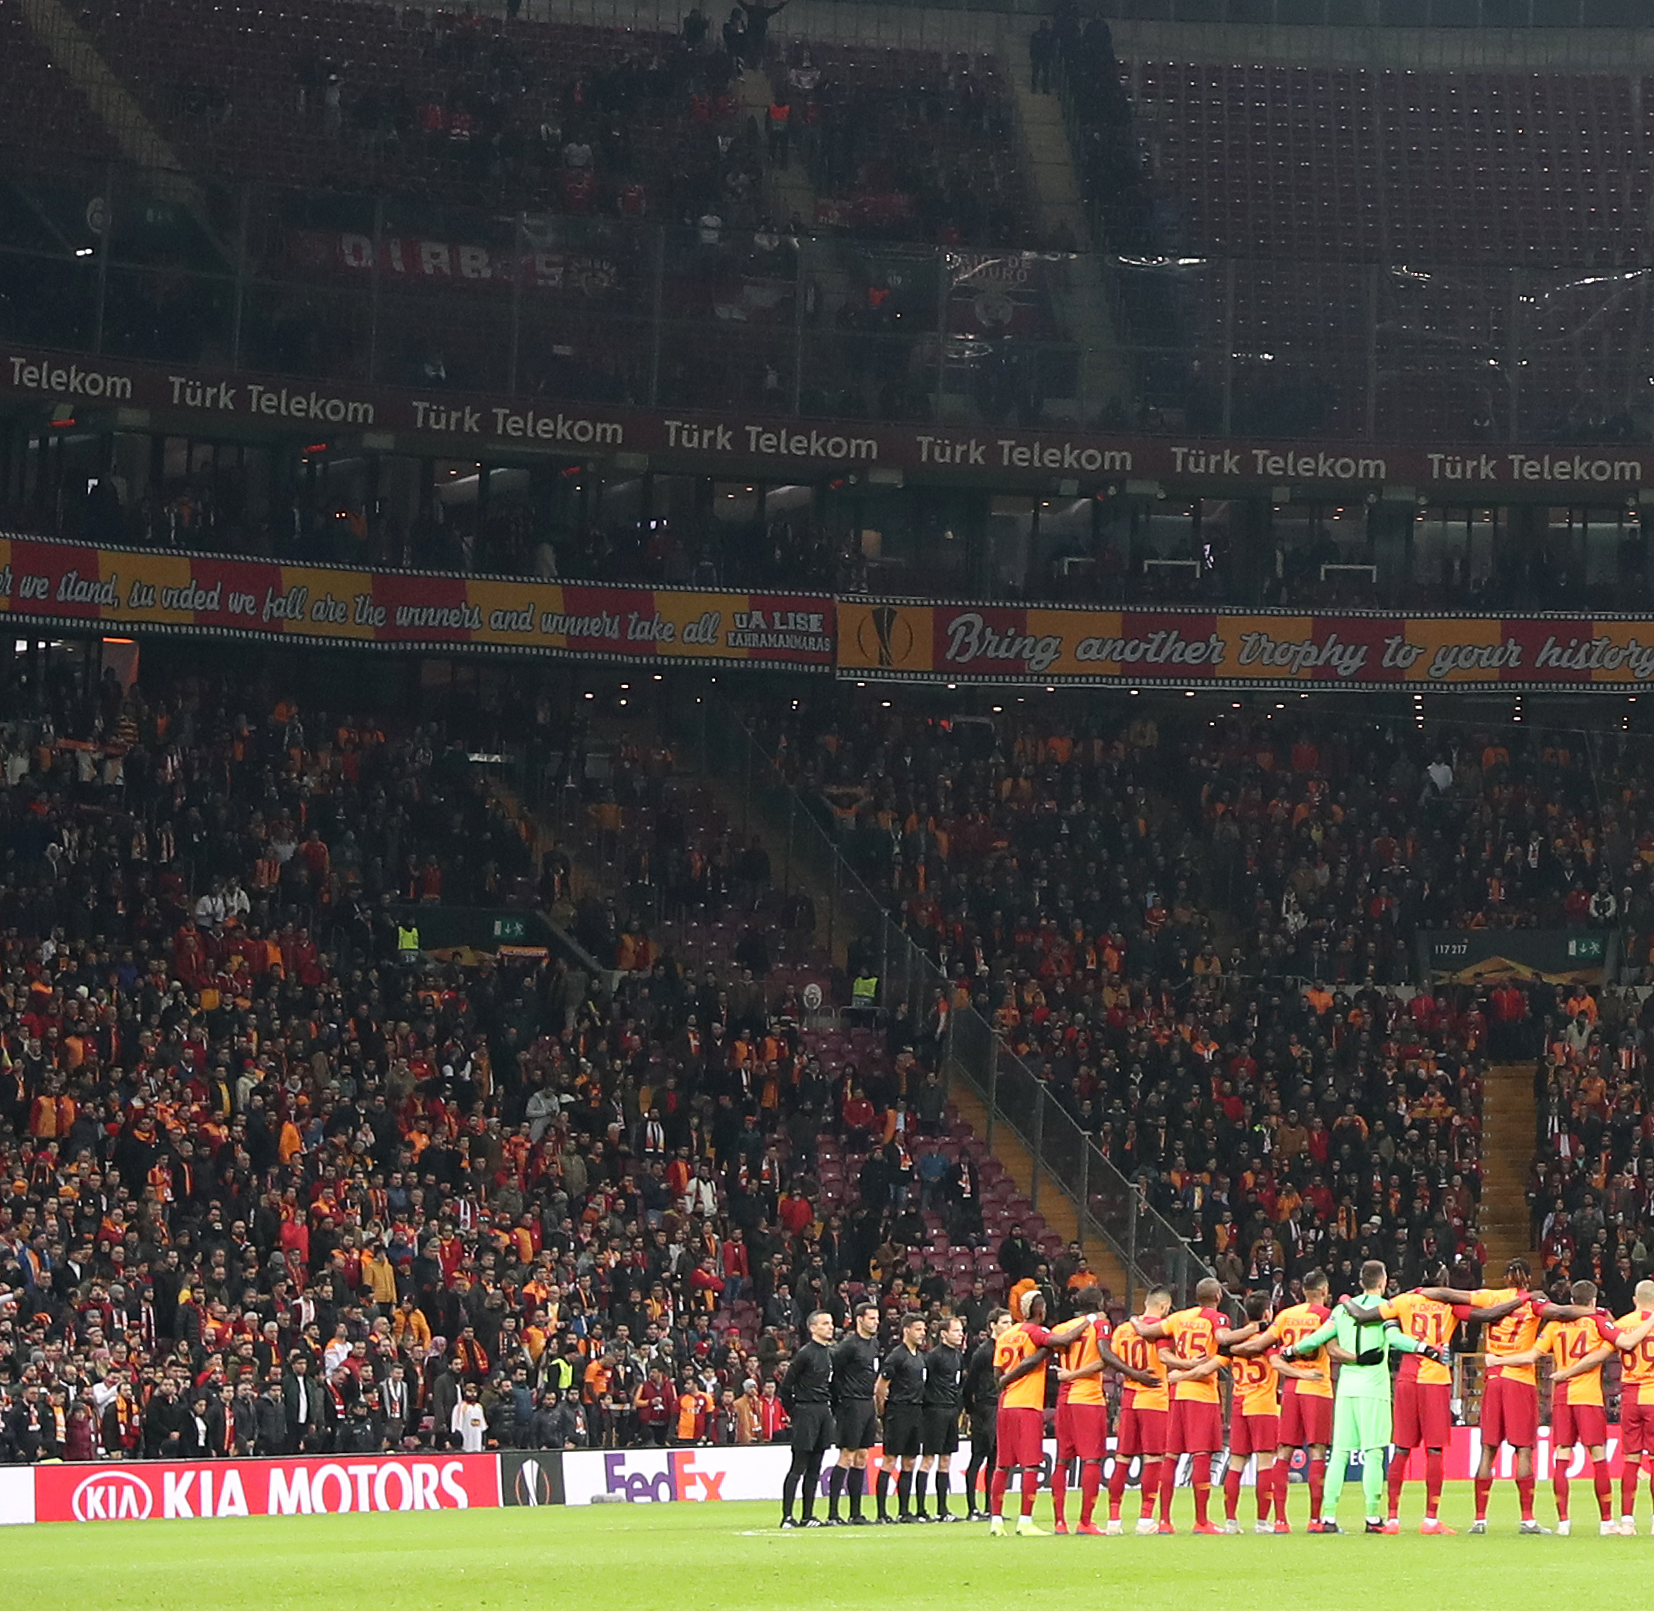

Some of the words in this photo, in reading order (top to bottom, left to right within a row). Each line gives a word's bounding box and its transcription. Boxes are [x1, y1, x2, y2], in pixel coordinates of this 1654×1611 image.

[10, 357, 131, 398] Telekom
[169, 376, 236, 409] Türk
[247, 385, 373, 423] Telekom
[412, 401, 481, 432] Türk
[492, 408, 622, 443] Telekom
[665, 421, 732, 450] Türk
[745, 426, 877, 459] Telekom
[917, 436, 985, 464] Türk
[998, 440, 1131, 470] Telekom
[1171, 447, 1240, 474] Türk
[1252, 450, 1385, 478] Telekom
[1427, 454, 1496, 479] Türk
[1508, 455, 1641, 481] Telekom
[19, 575, 48, 600] we
[56, 570, 118, 608] stand,
[228, 592, 256, 616] we
[261, 586, 307, 623] fall
[311, 596, 347, 623] are
[355, 595, 387, 628] the
[490, 603, 534, 632] and
[626, 611, 675, 643] take
[683, 612, 720, 644] all
[772, 611, 824, 633] LISE
[945, 612, 1061, 672] Bring
[1076, 630, 1225, 665] another
[1239, 632, 1369, 677] trophy
[1381, 635, 1425, 668] to
[1431, 637, 1522, 678] your
[1121, 1338, 1149, 1370] 10
[1557, 1331, 1588, 1367] 14
[84, 1474, 137, 1518] KIA
[164, 1468, 249, 1517] KIA
[268, 1460, 469, 1514] MOTORS
[604, 1451, 726, 1504] FedEx
